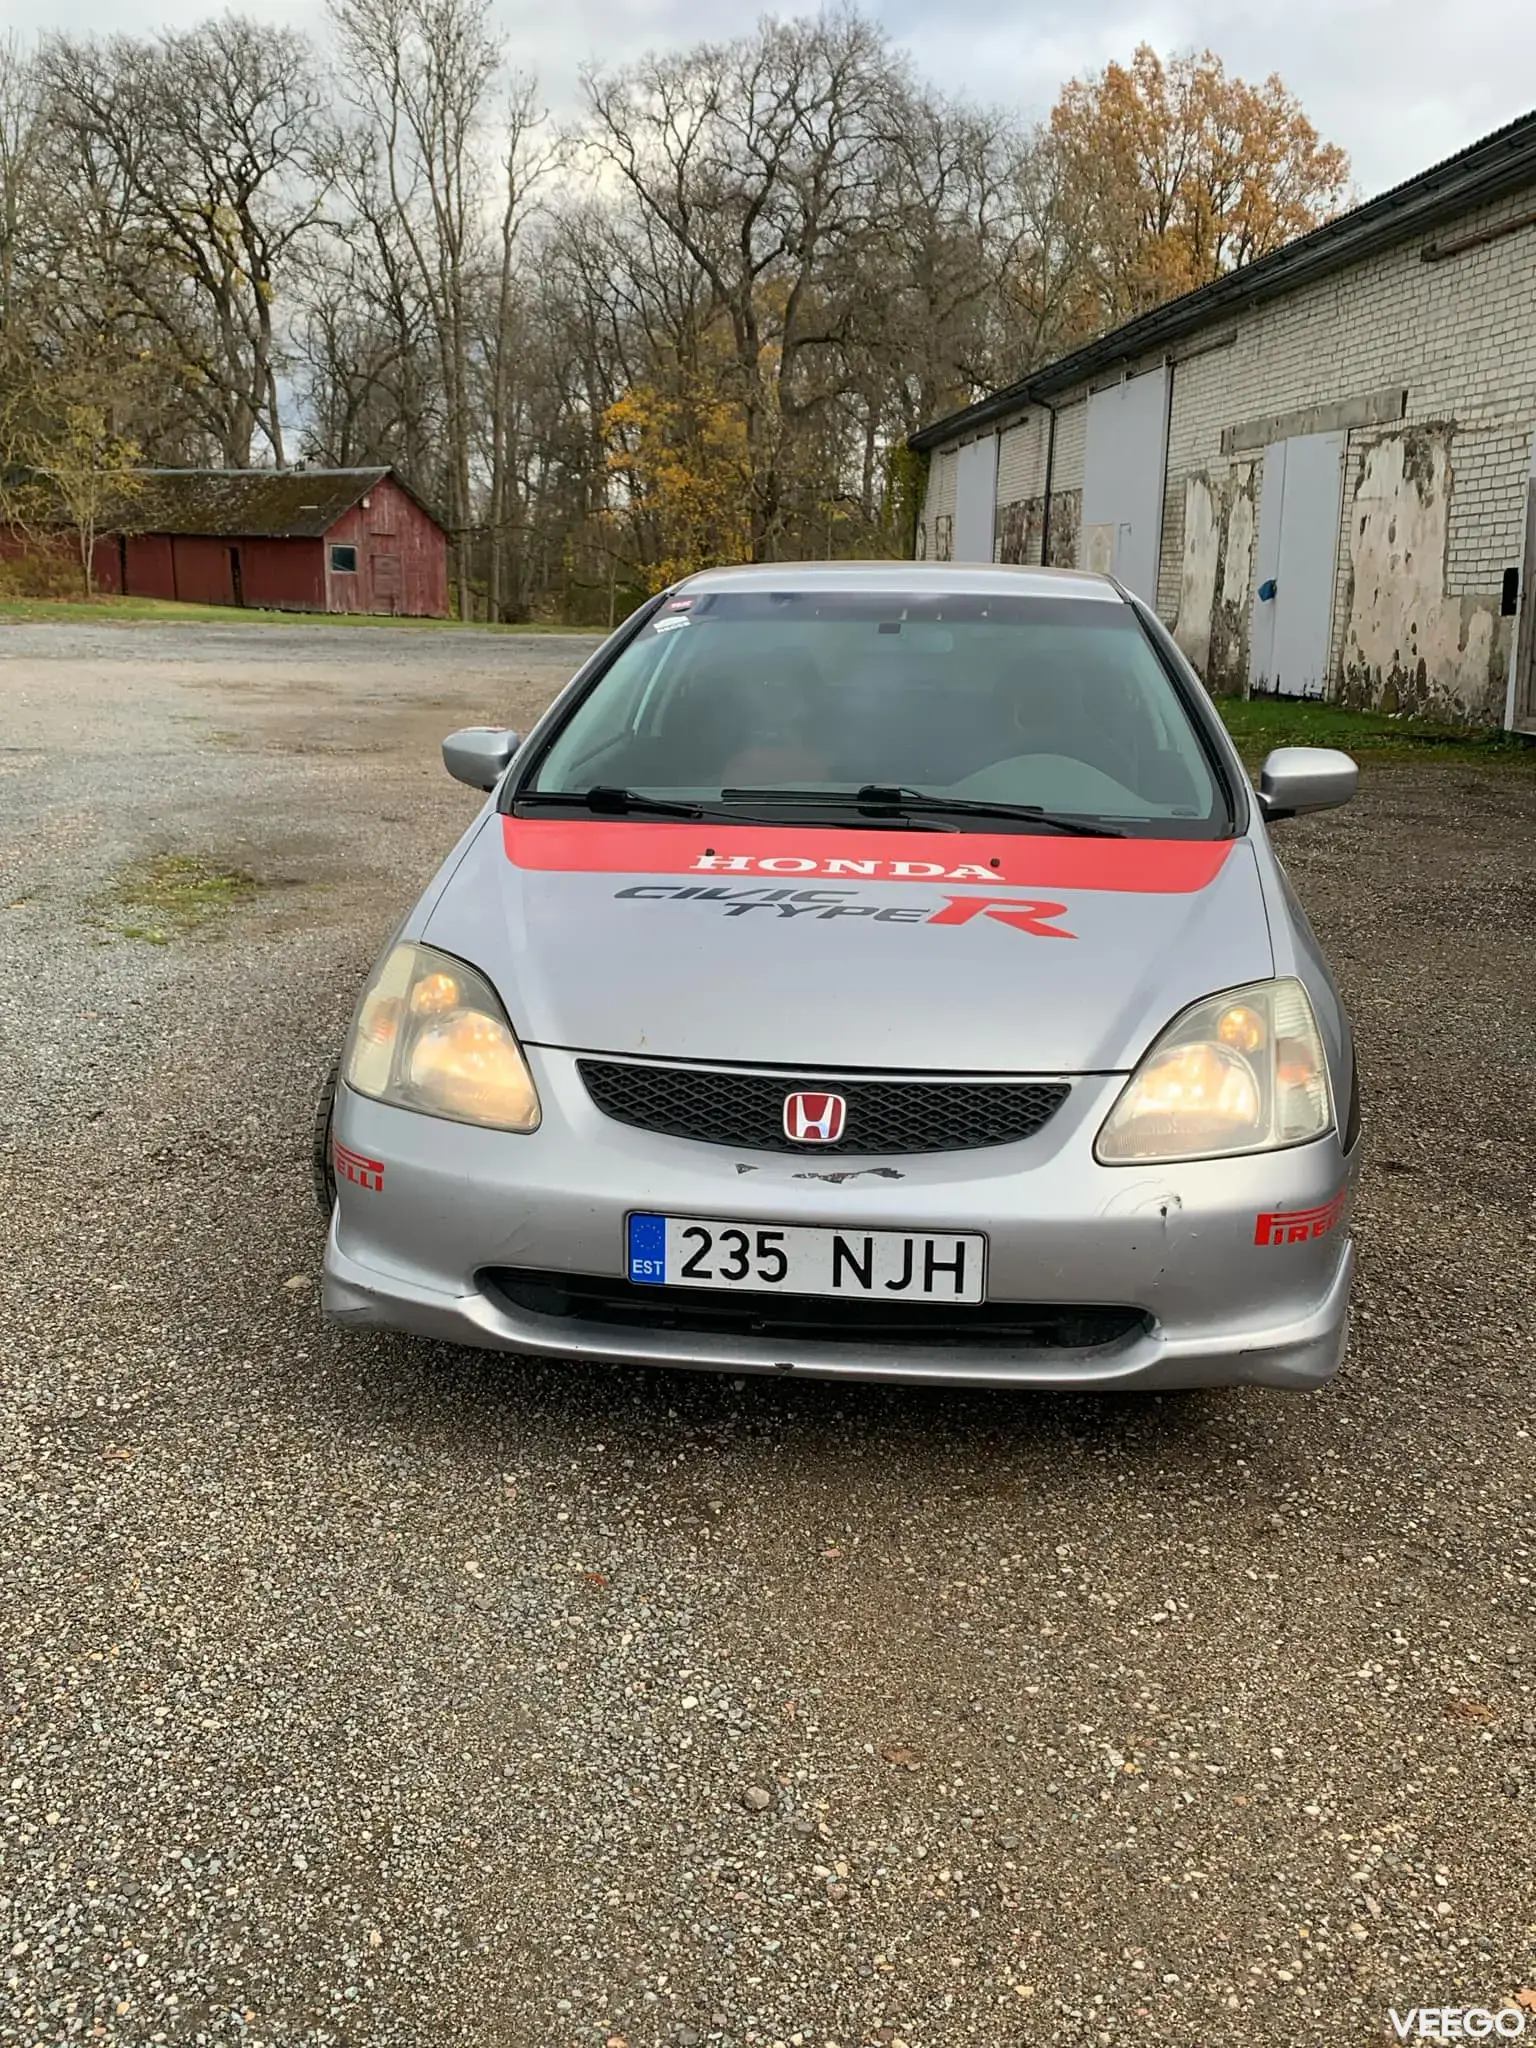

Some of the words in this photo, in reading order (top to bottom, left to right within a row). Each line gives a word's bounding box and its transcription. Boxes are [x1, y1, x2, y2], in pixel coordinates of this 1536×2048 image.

[690, 855, 1005, 880] HONDA
[614, 886, 858, 903] CIVIC
[723, 902, 930, 923] TYPE
[926, 895, 1079, 939] R
[334, 1138, 385, 1192] ELLI
[633, 1259, 663, 1276] EST
[680, 1226, 788, 1284] 235
[832, 1235, 966, 1294] NJH
